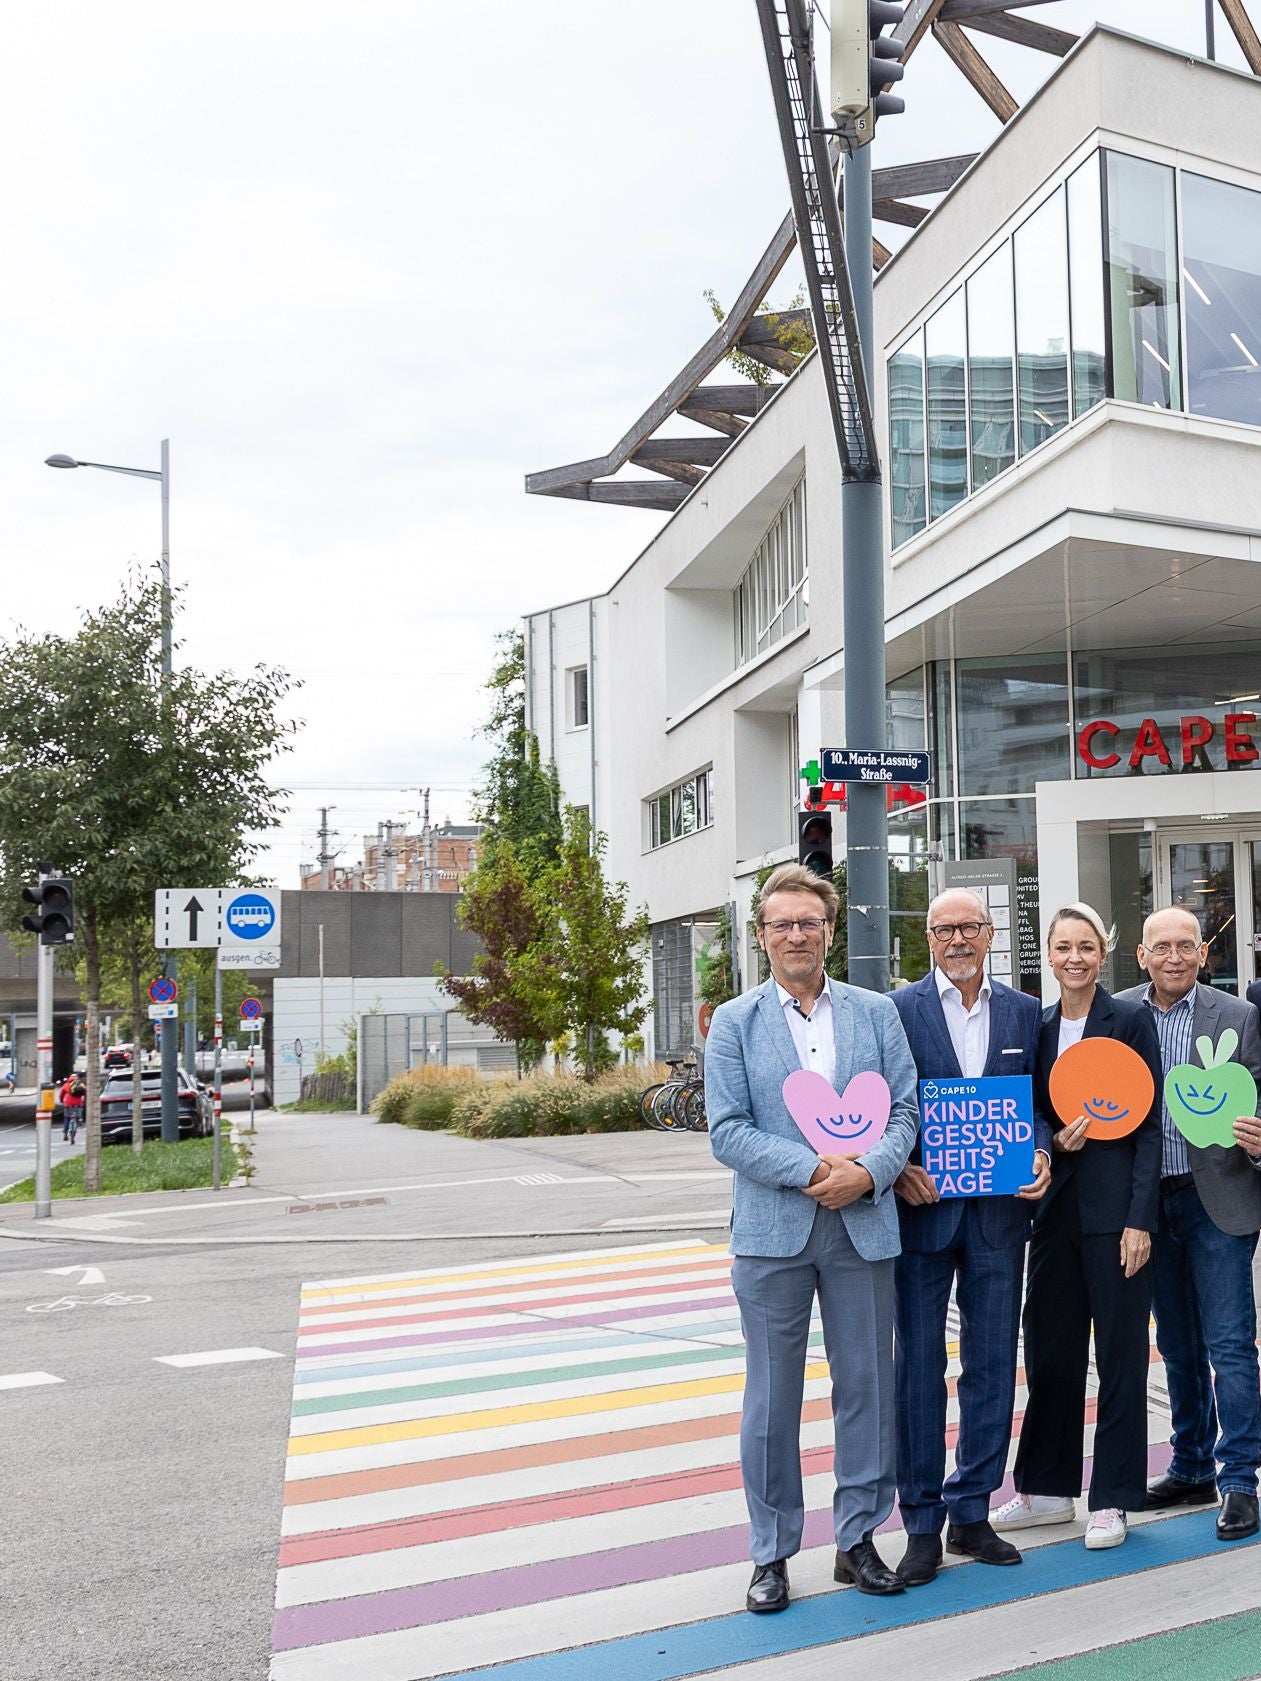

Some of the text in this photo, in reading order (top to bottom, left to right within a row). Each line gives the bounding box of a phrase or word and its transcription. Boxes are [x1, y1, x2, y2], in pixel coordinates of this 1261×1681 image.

[859, 119, 865, 129] 5
[1078, 713, 1259, 769] CAPE
[849, 752, 922, 769] Maria-Lassnig-
[860, 767, 893, 780] Straße
[1018, 876, 1040, 884] GROU
[221, 955, 252, 964] ausgen.
[924, 1098, 1019, 1123] KINDER
[924, 1121, 1032, 1147] GESUND
[925, 1147, 996, 1172] HEITS
[928, 1171, 993, 1195] TAGE
